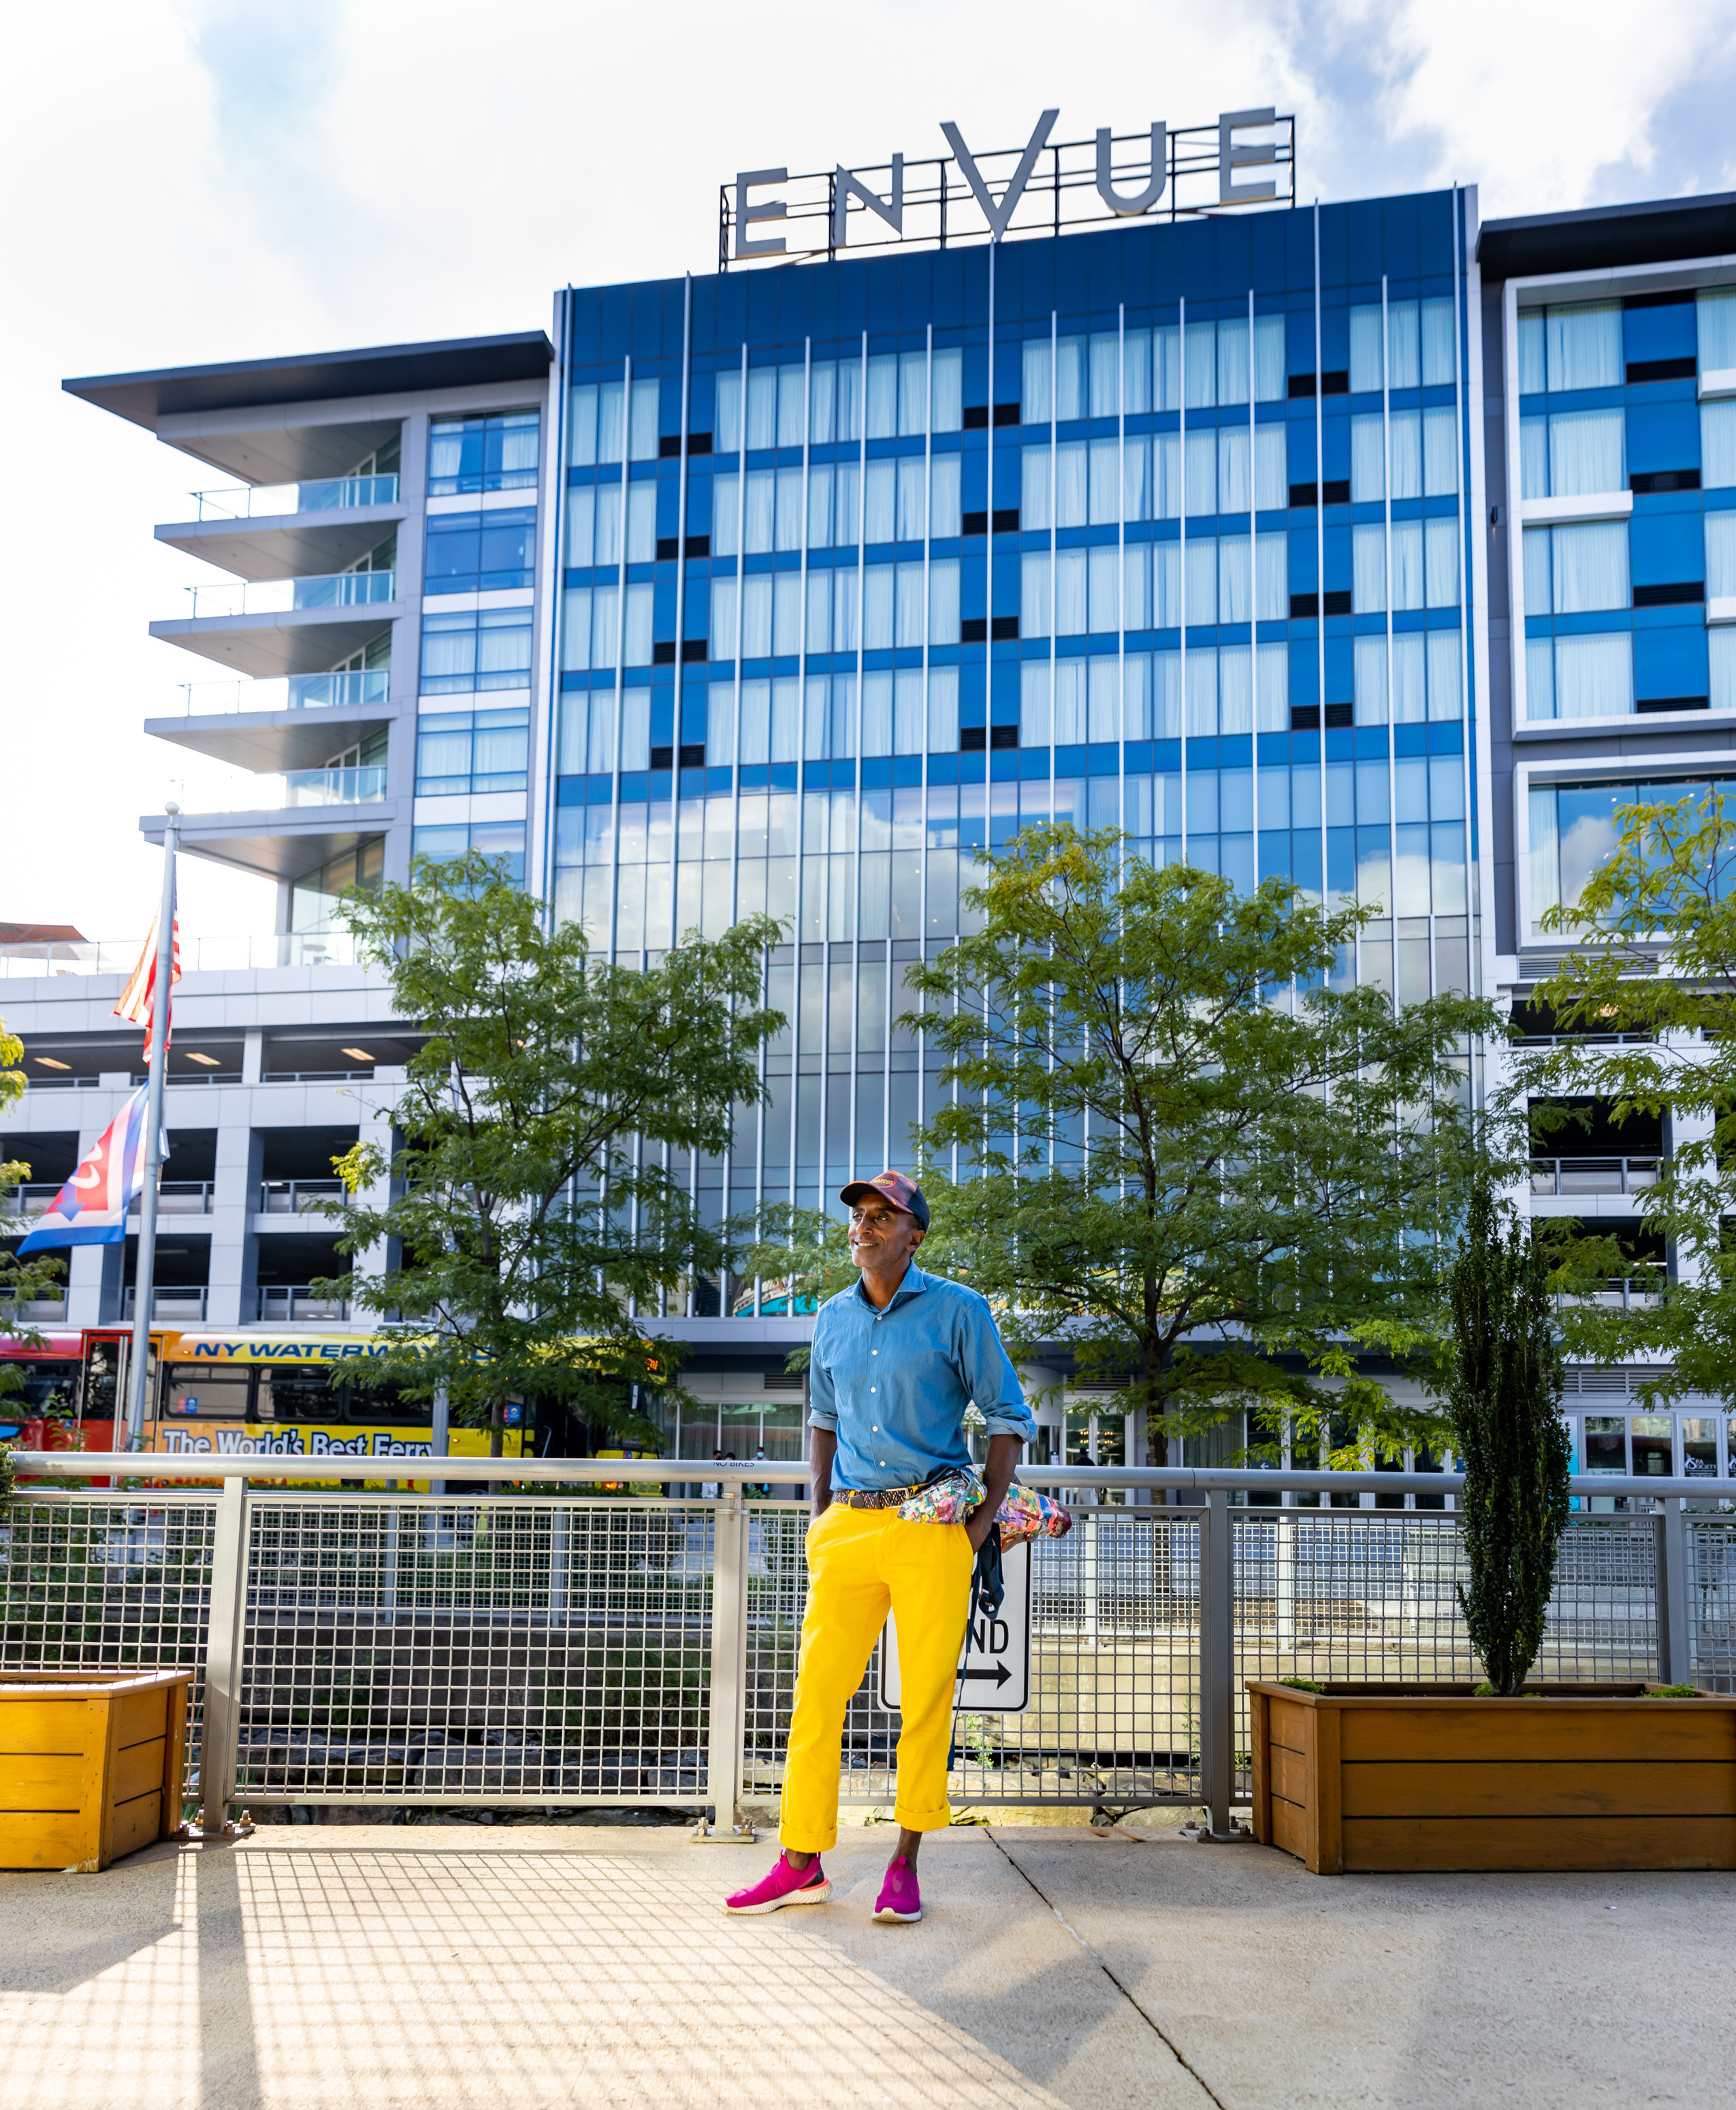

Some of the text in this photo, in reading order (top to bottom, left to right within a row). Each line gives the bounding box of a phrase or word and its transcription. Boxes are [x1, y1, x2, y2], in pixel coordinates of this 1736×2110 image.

[736, 106, 1276, 259] ENVUE
[195, 1343, 246, 1357] NY
[162, 1428, 212, 1454] The
[216, 1428, 304, 1454] World's
[311, 1432, 368, 1455] Best
[965, 1619, 1009, 1654] ND
